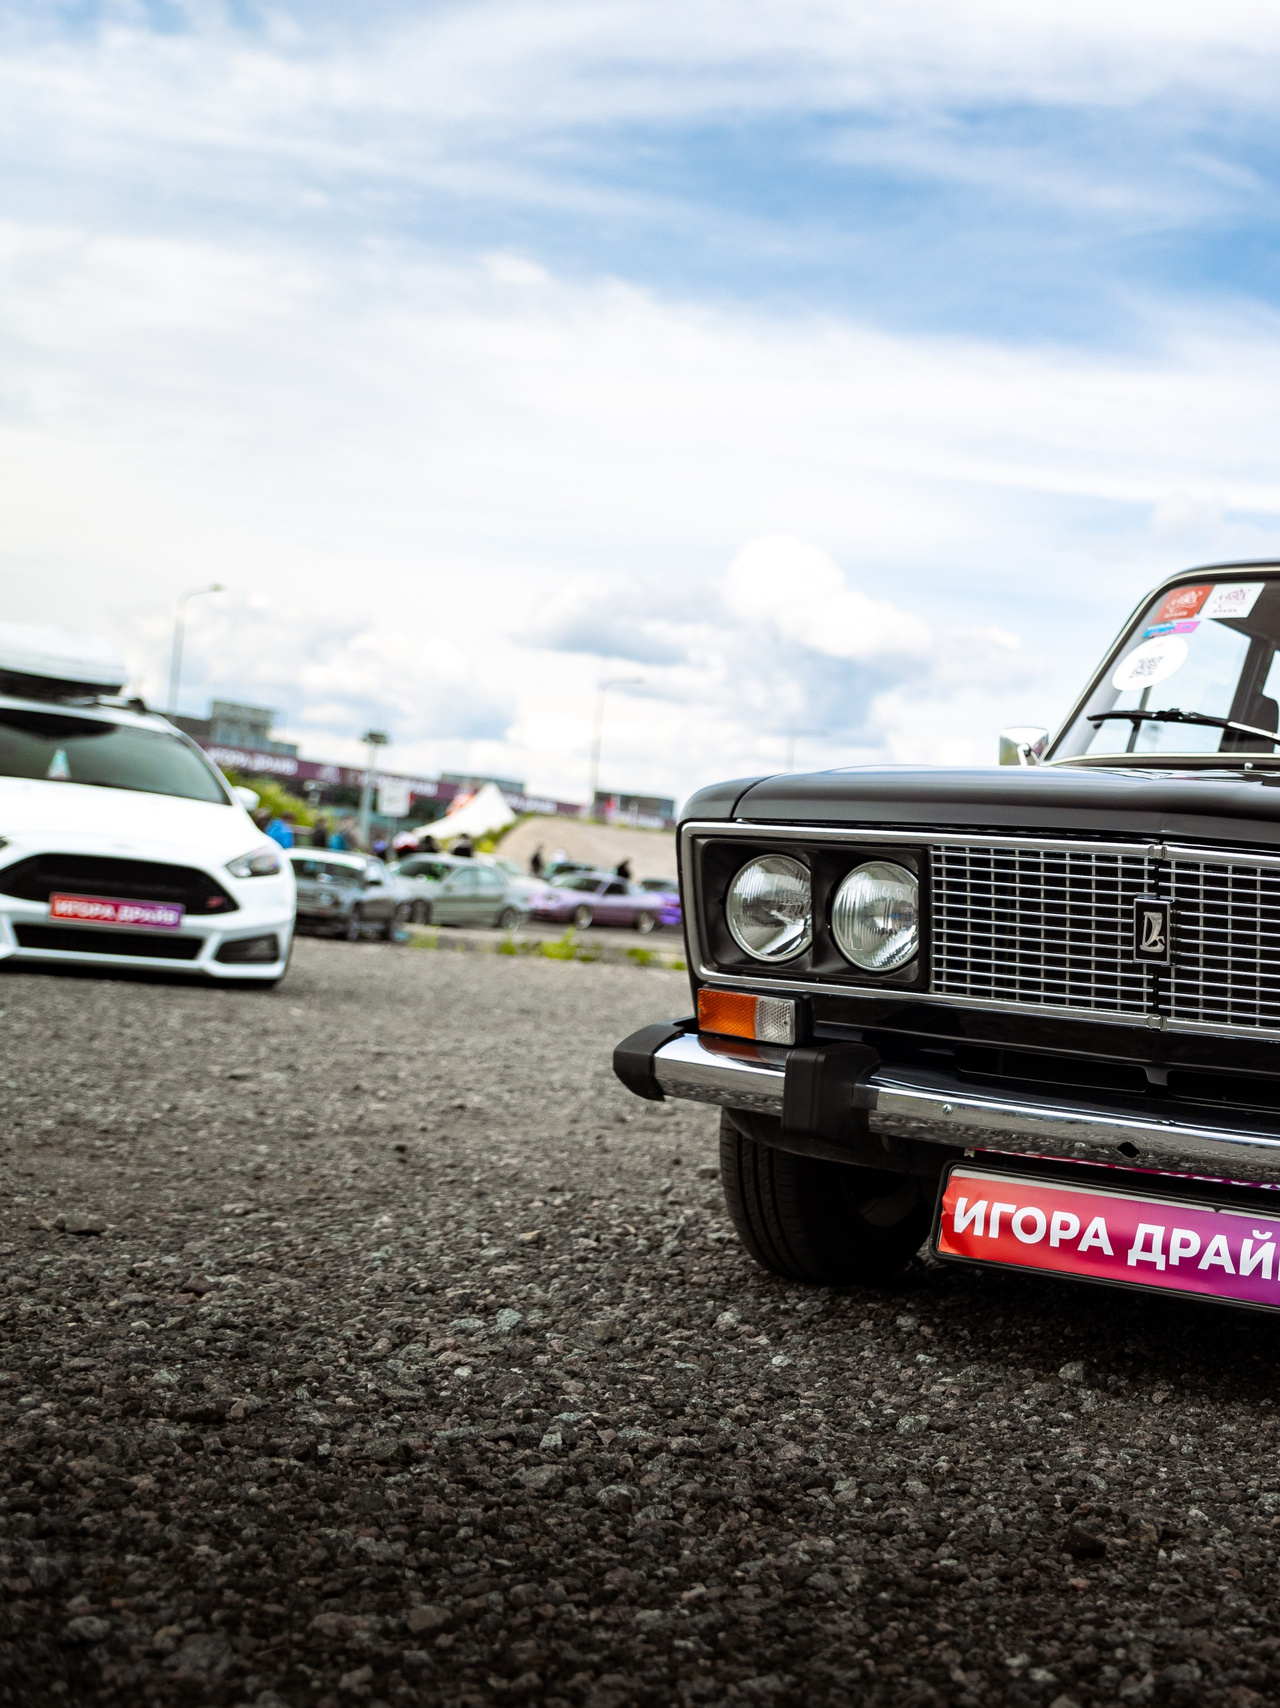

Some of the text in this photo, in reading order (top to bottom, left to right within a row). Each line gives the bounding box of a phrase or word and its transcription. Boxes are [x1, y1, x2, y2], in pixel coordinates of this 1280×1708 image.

[55, 899, 180, 926] ИГОРА ДРАЙВ
[953, 1196, 1114, 1256] ИГОРА
